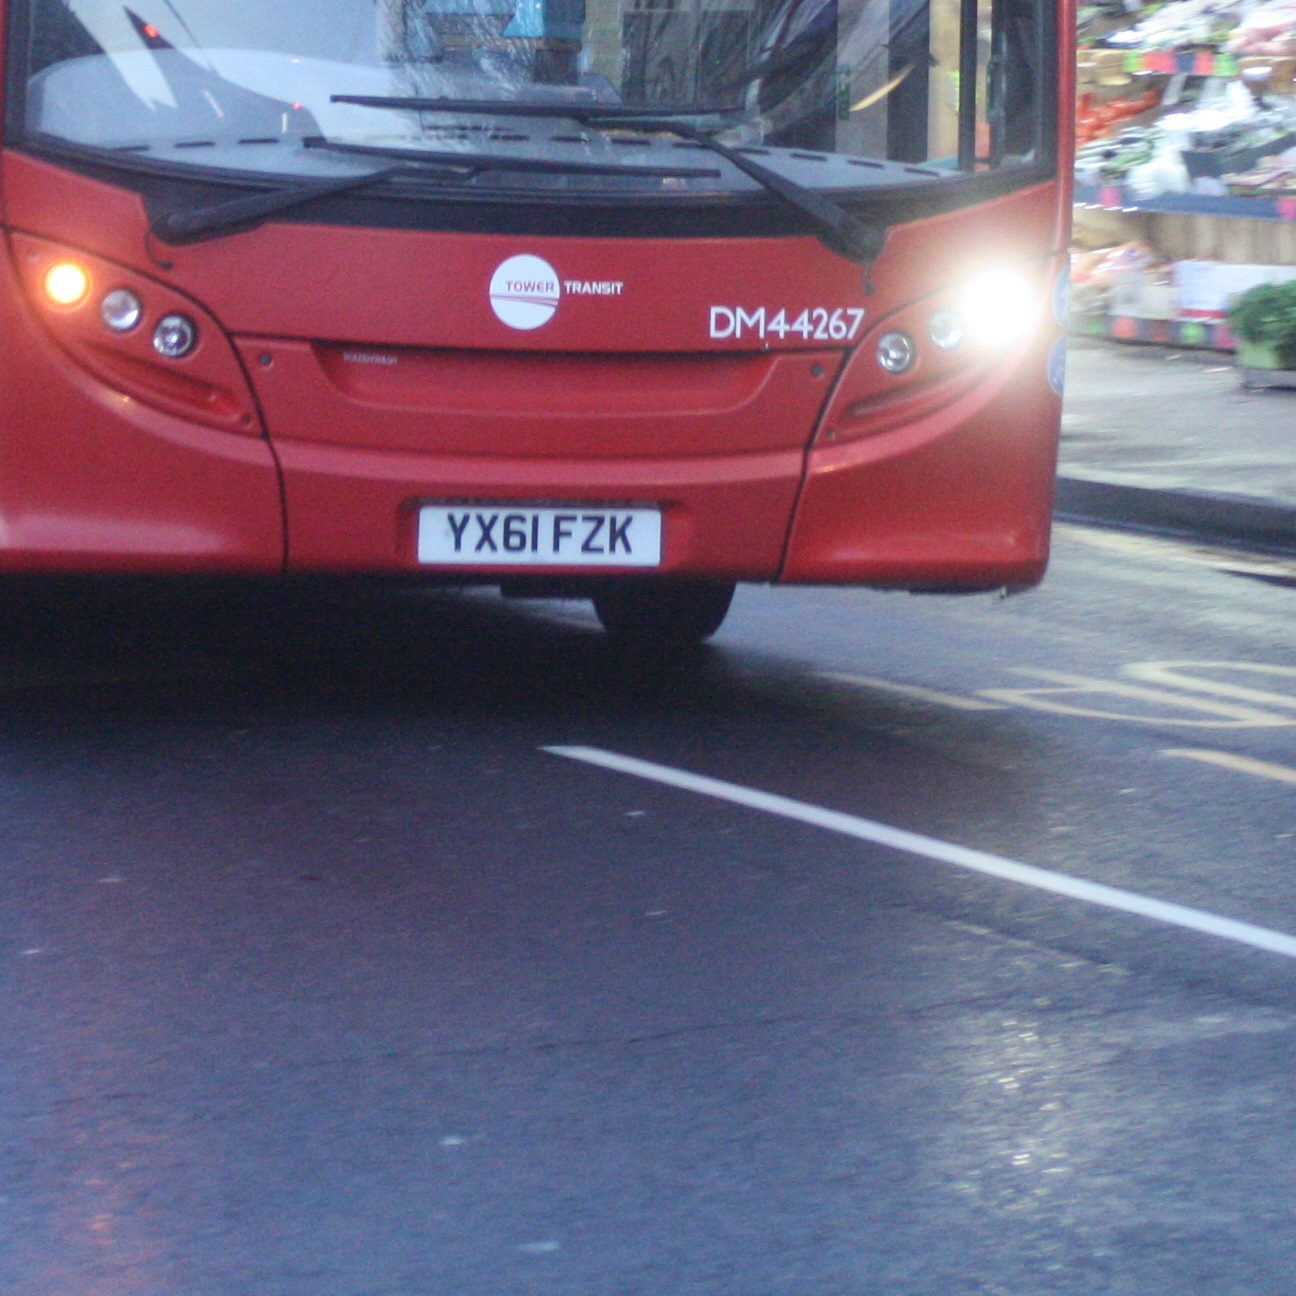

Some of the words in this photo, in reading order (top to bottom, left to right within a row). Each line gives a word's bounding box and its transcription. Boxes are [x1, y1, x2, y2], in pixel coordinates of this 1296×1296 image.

[505, 279, 555, 294] TOWER
[564, 280, 624, 296] TRANSIT
[709, 306, 865, 340] DM44267
[446, 512, 540, 554] YX61
[552, 513, 635, 555] FZK
